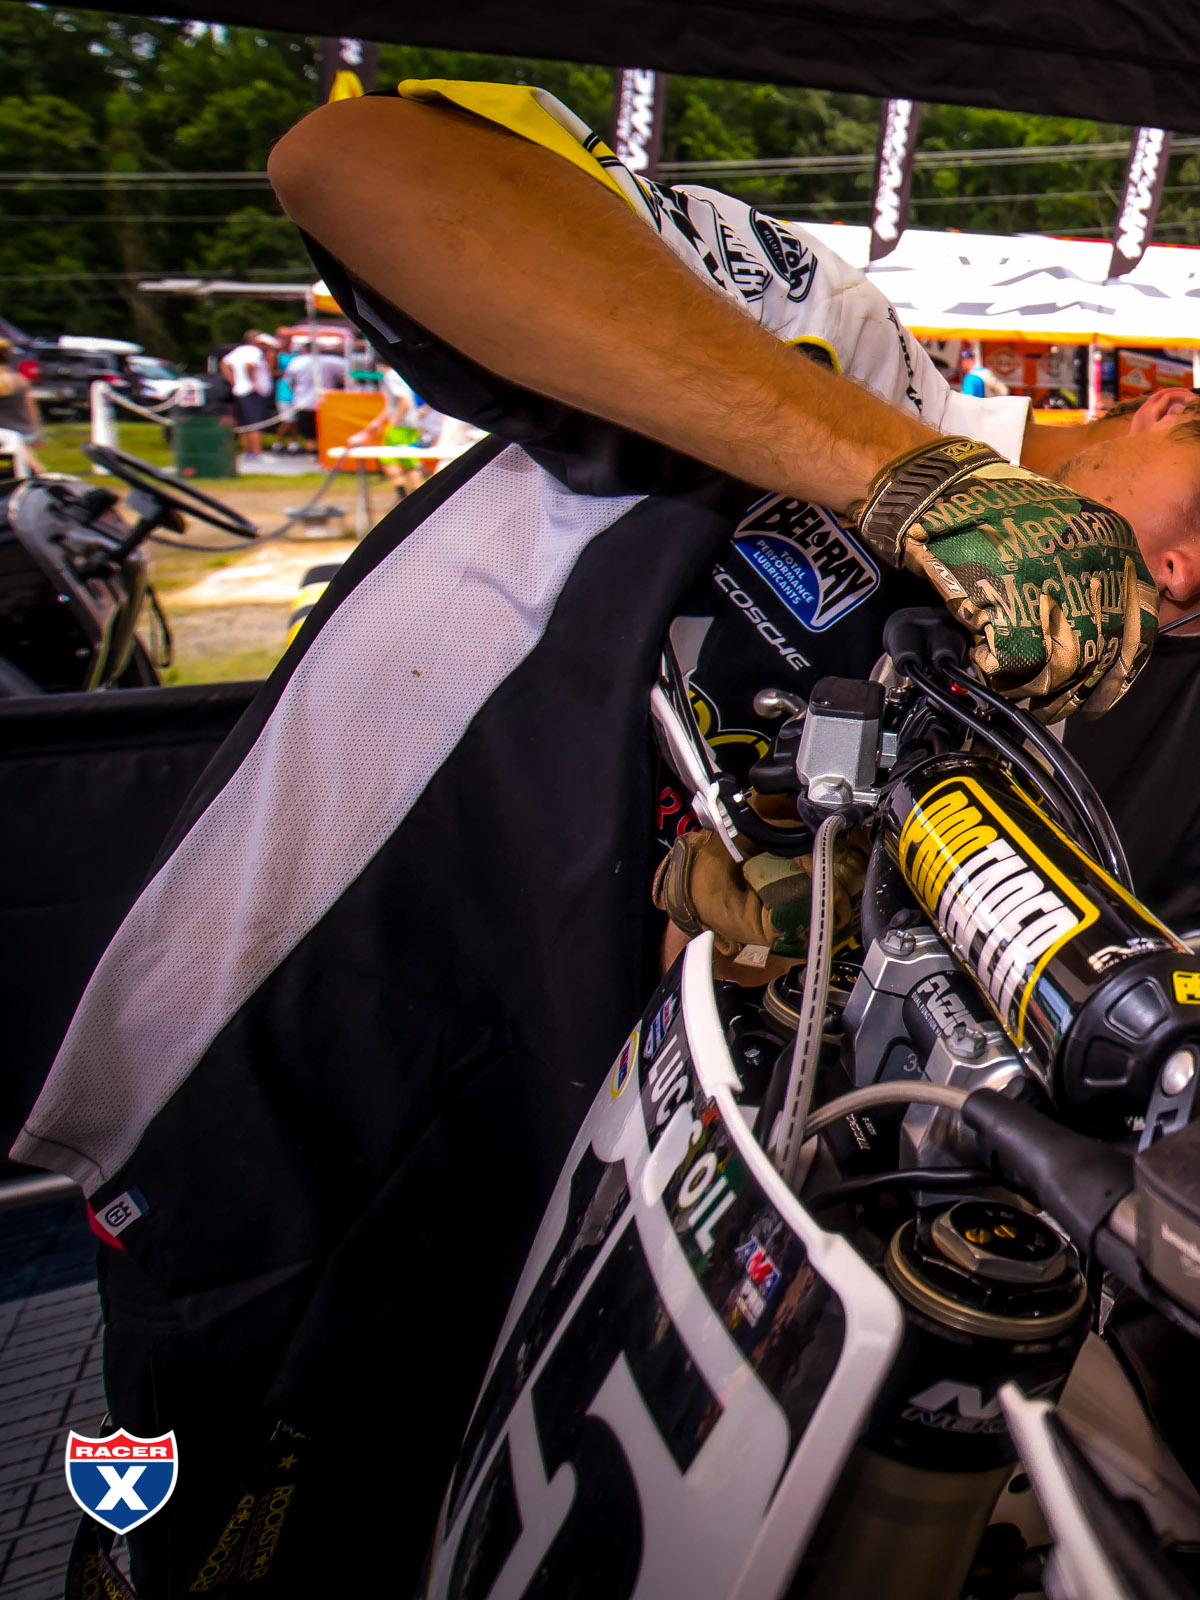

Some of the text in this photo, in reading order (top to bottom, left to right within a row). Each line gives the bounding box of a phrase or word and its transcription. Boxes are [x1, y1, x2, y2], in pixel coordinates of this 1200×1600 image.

[752, 551, 800, 605] LUBRICANTS
[755, 539, 815, 604] PERFORMANCE
[781, 550, 805, 580] TOTAL
[678, 1151, 737, 1255] OIL
